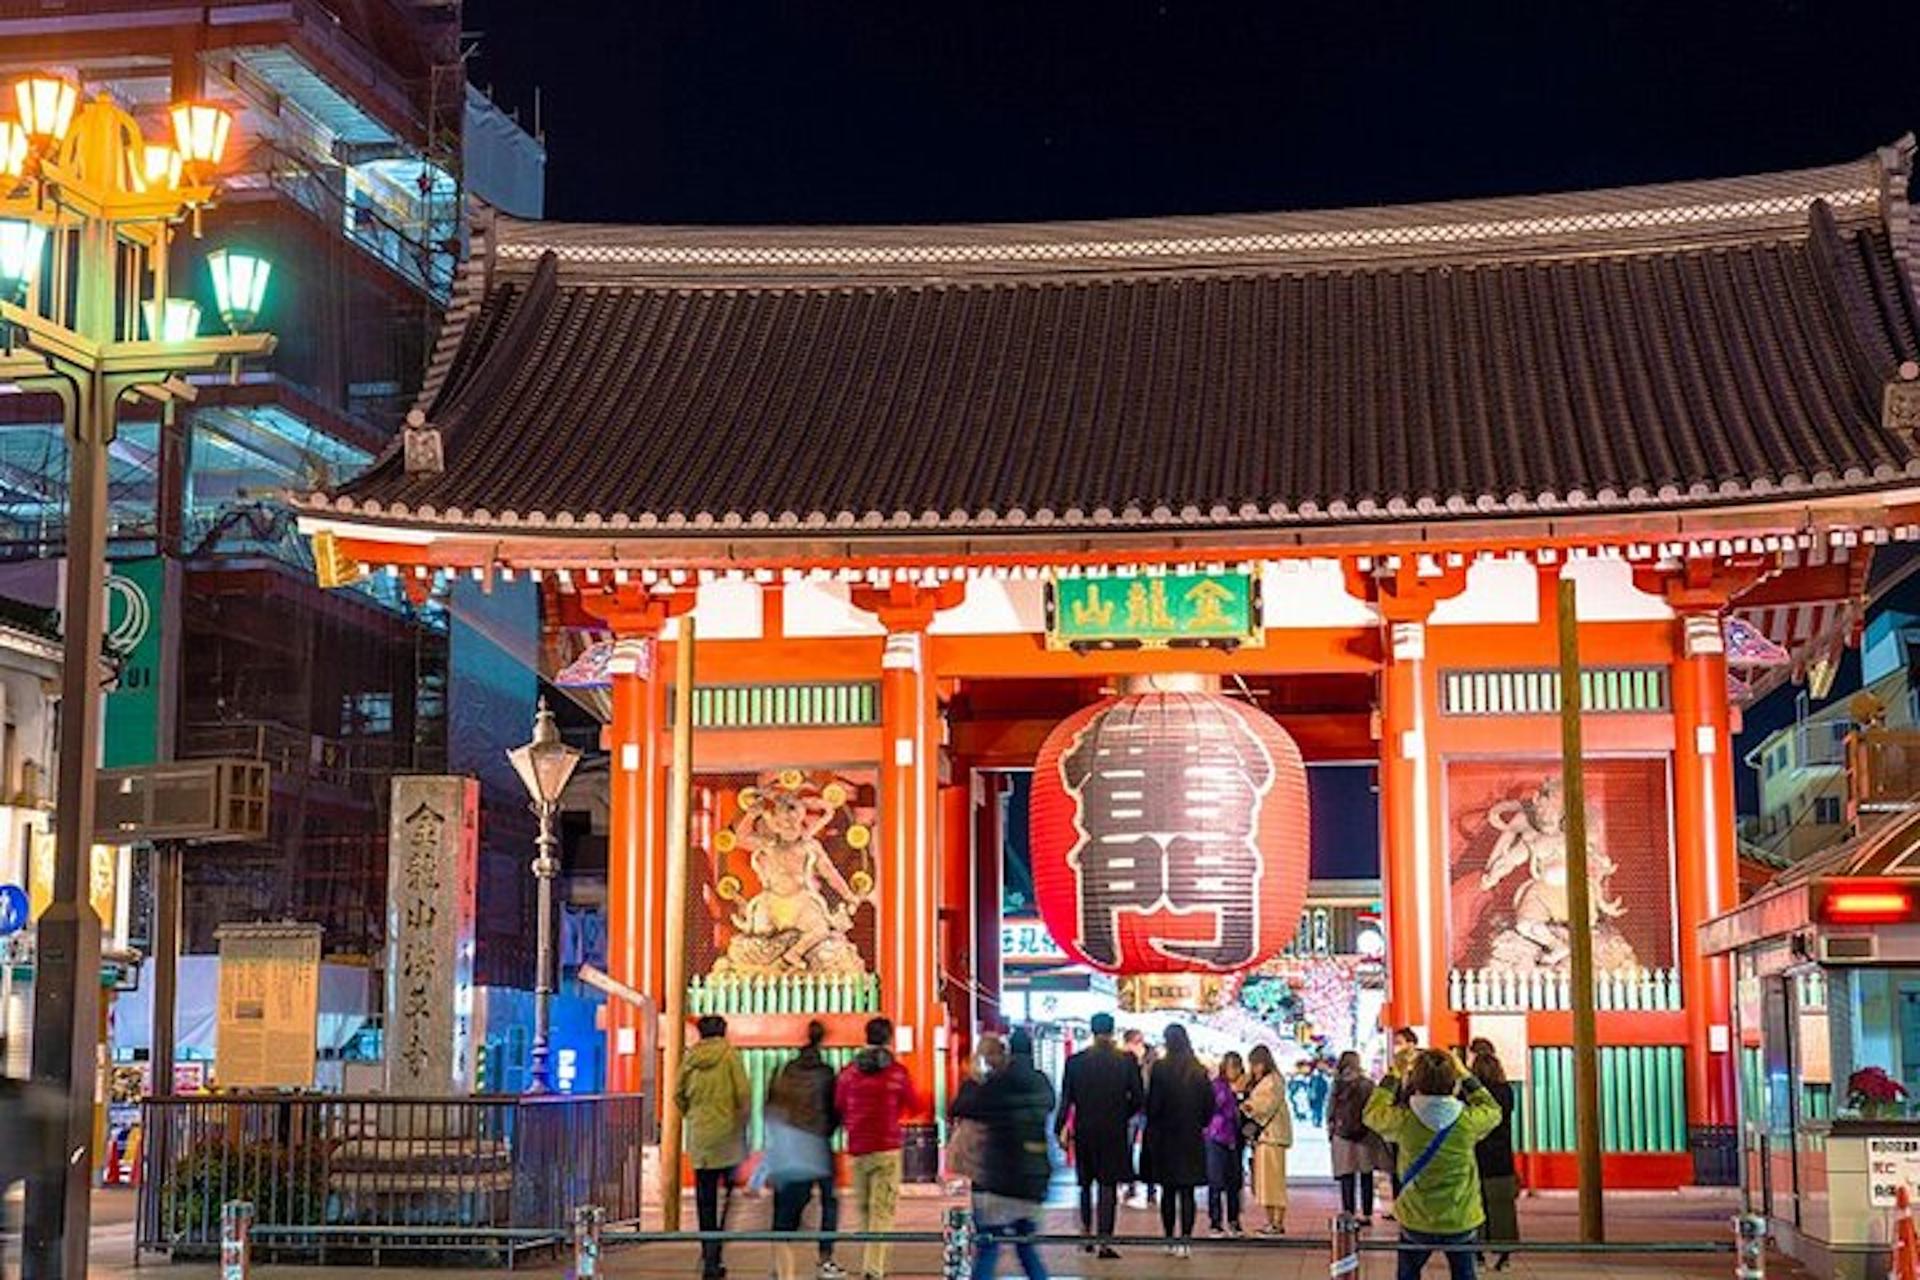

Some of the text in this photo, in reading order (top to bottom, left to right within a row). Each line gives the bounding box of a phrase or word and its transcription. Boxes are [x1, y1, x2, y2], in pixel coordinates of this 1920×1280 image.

[1073, 578, 1236, 630] 金龍山
[1058, 702, 1275, 967] 雷門
